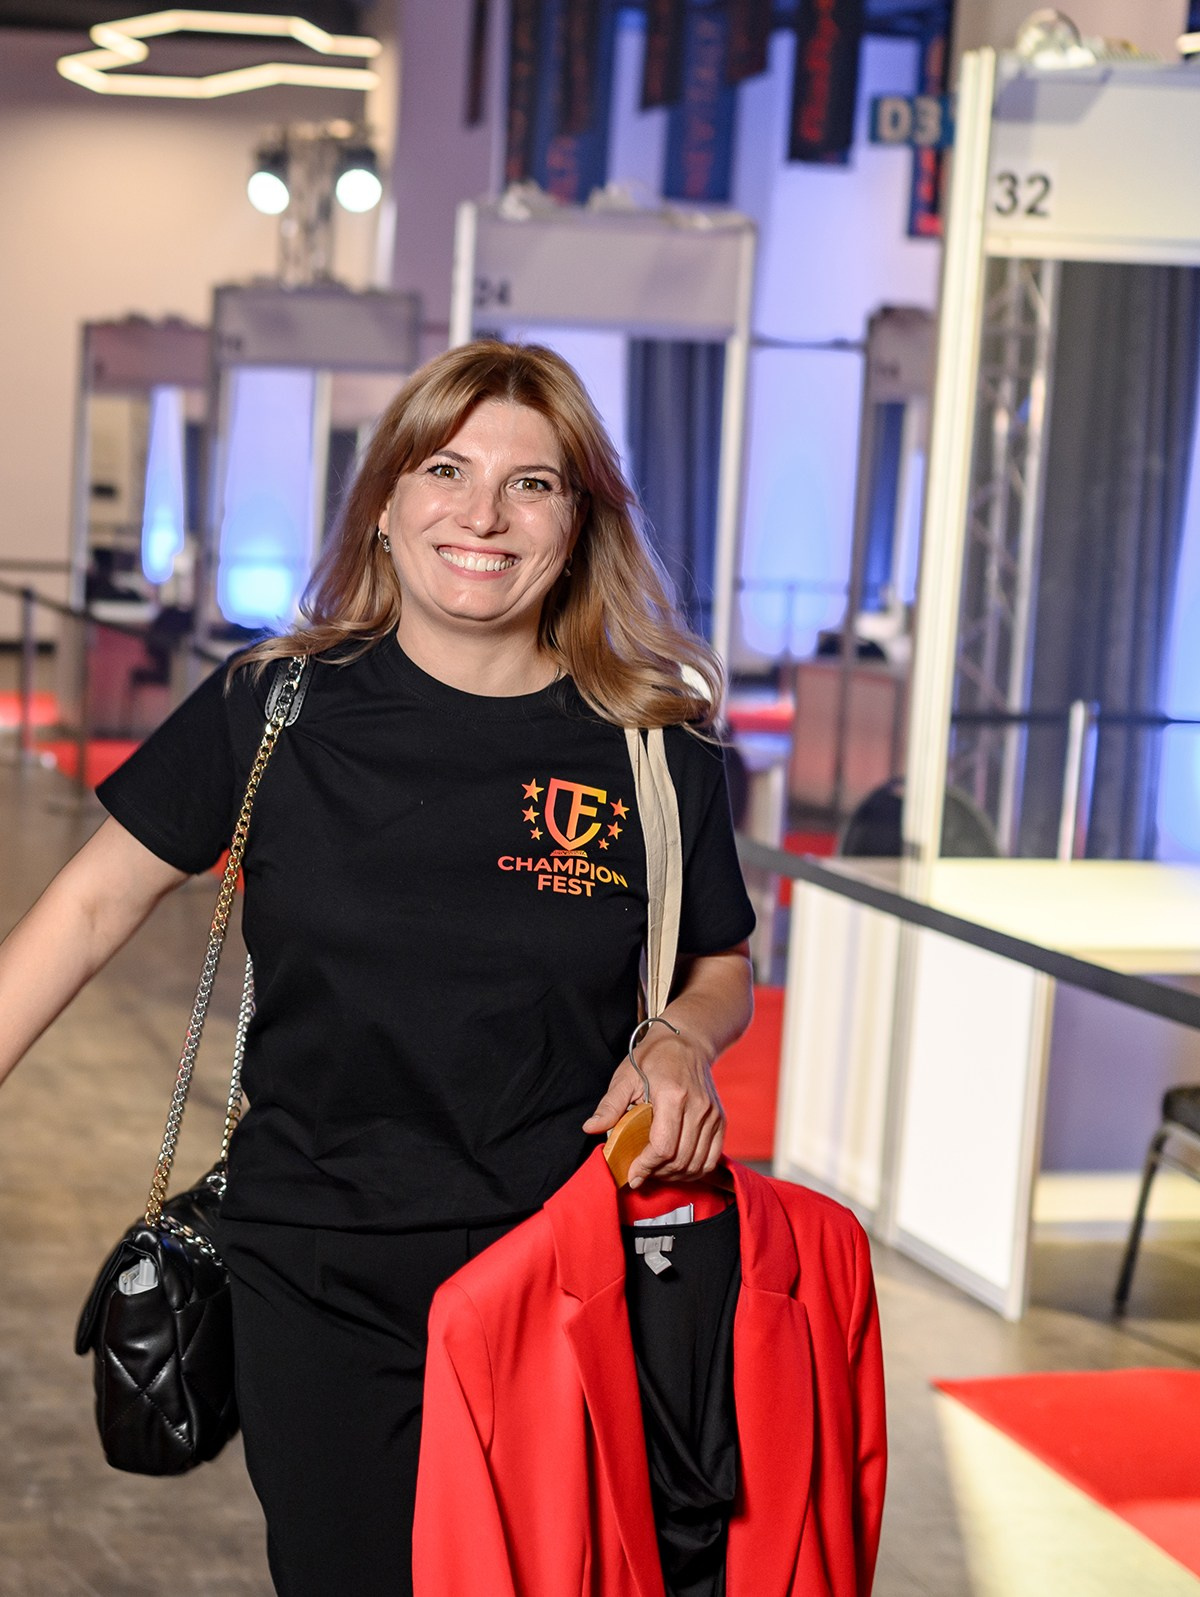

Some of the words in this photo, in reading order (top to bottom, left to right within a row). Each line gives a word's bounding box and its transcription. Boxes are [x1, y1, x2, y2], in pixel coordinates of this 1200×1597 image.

[994, 170, 1051, 218] 32
[497, 855, 629, 889] CHAMPION
[537, 874, 596, 898] FEST
